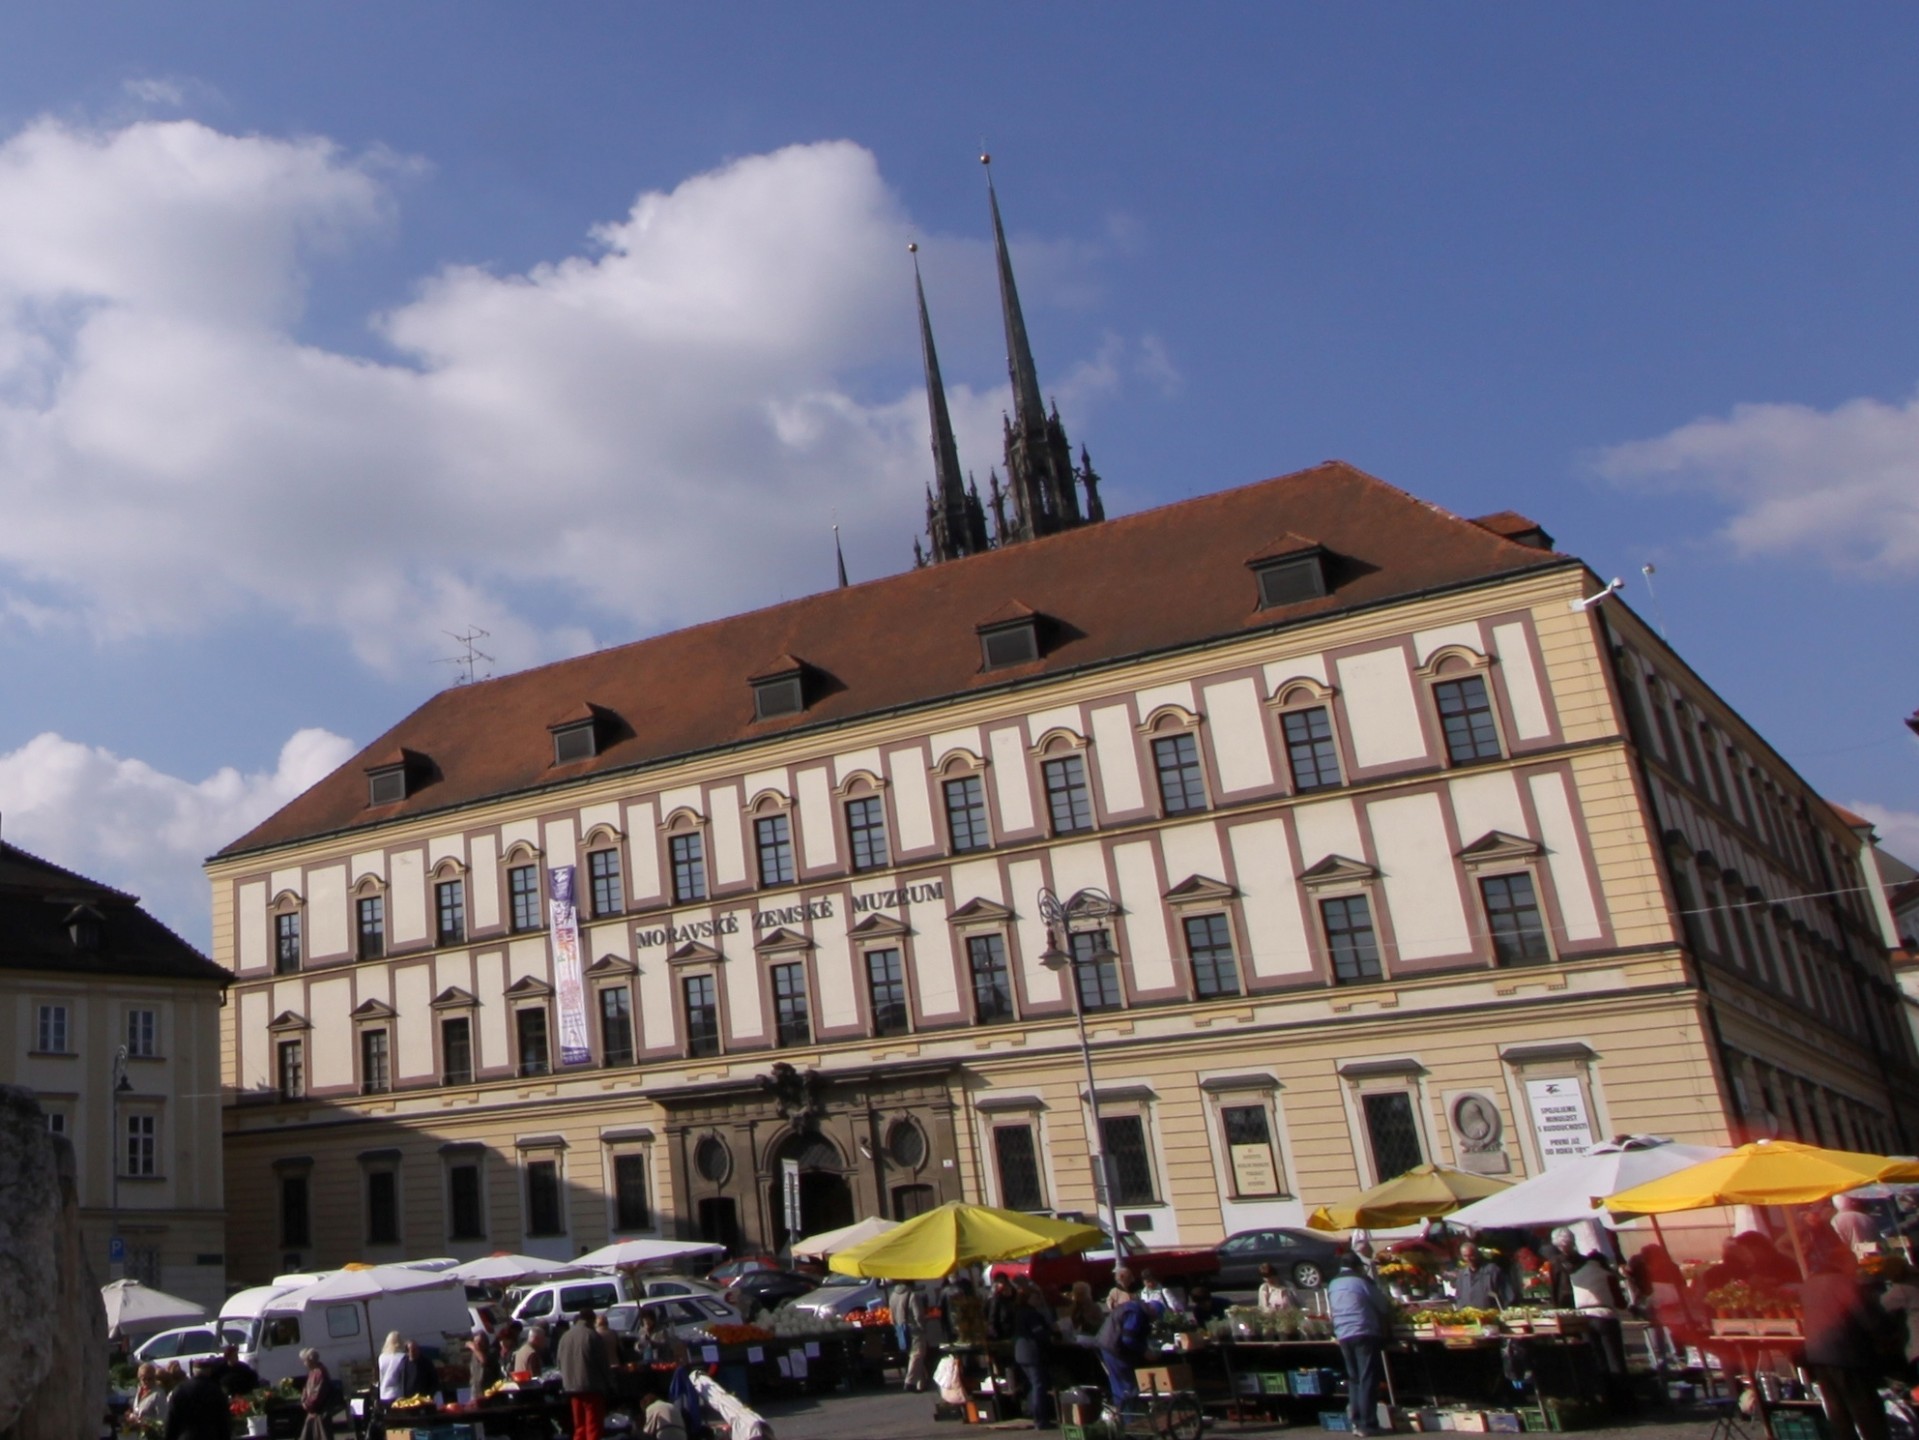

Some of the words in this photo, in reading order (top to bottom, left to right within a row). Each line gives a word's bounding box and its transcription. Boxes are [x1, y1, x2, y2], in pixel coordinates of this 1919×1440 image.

[635, 911, 740, 949] MORAVSKÉ
[751, 895, 834, 930] ZEMSKÉ
[850, 882, 945, 914] MUZEUM
[112, 1240, 122, 1255] P
